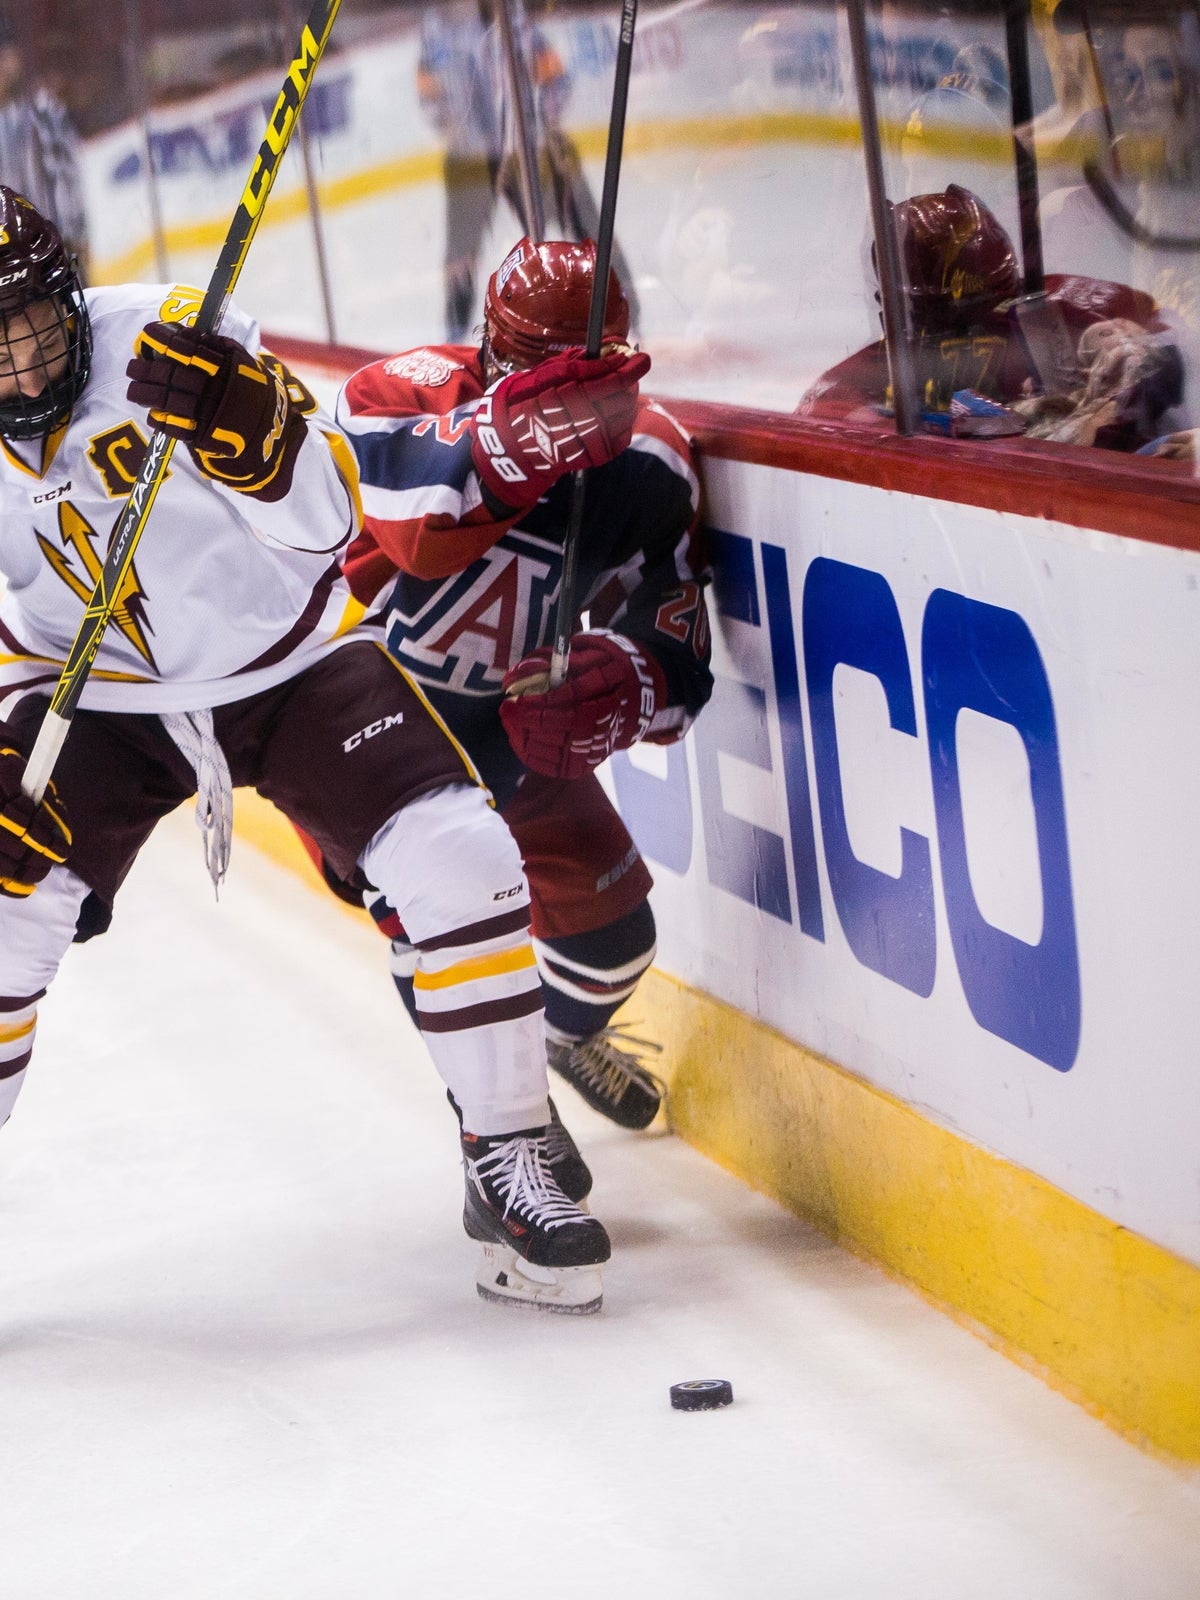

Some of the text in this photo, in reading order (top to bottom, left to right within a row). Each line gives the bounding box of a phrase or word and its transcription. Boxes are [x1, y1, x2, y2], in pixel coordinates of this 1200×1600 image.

[240, 23, 320, 219] CCM
[32, 480, 73, 504] CCM
[112, 430, 167, 567] ULTRA TACKS
[341, 711, 404, 753] CCM
